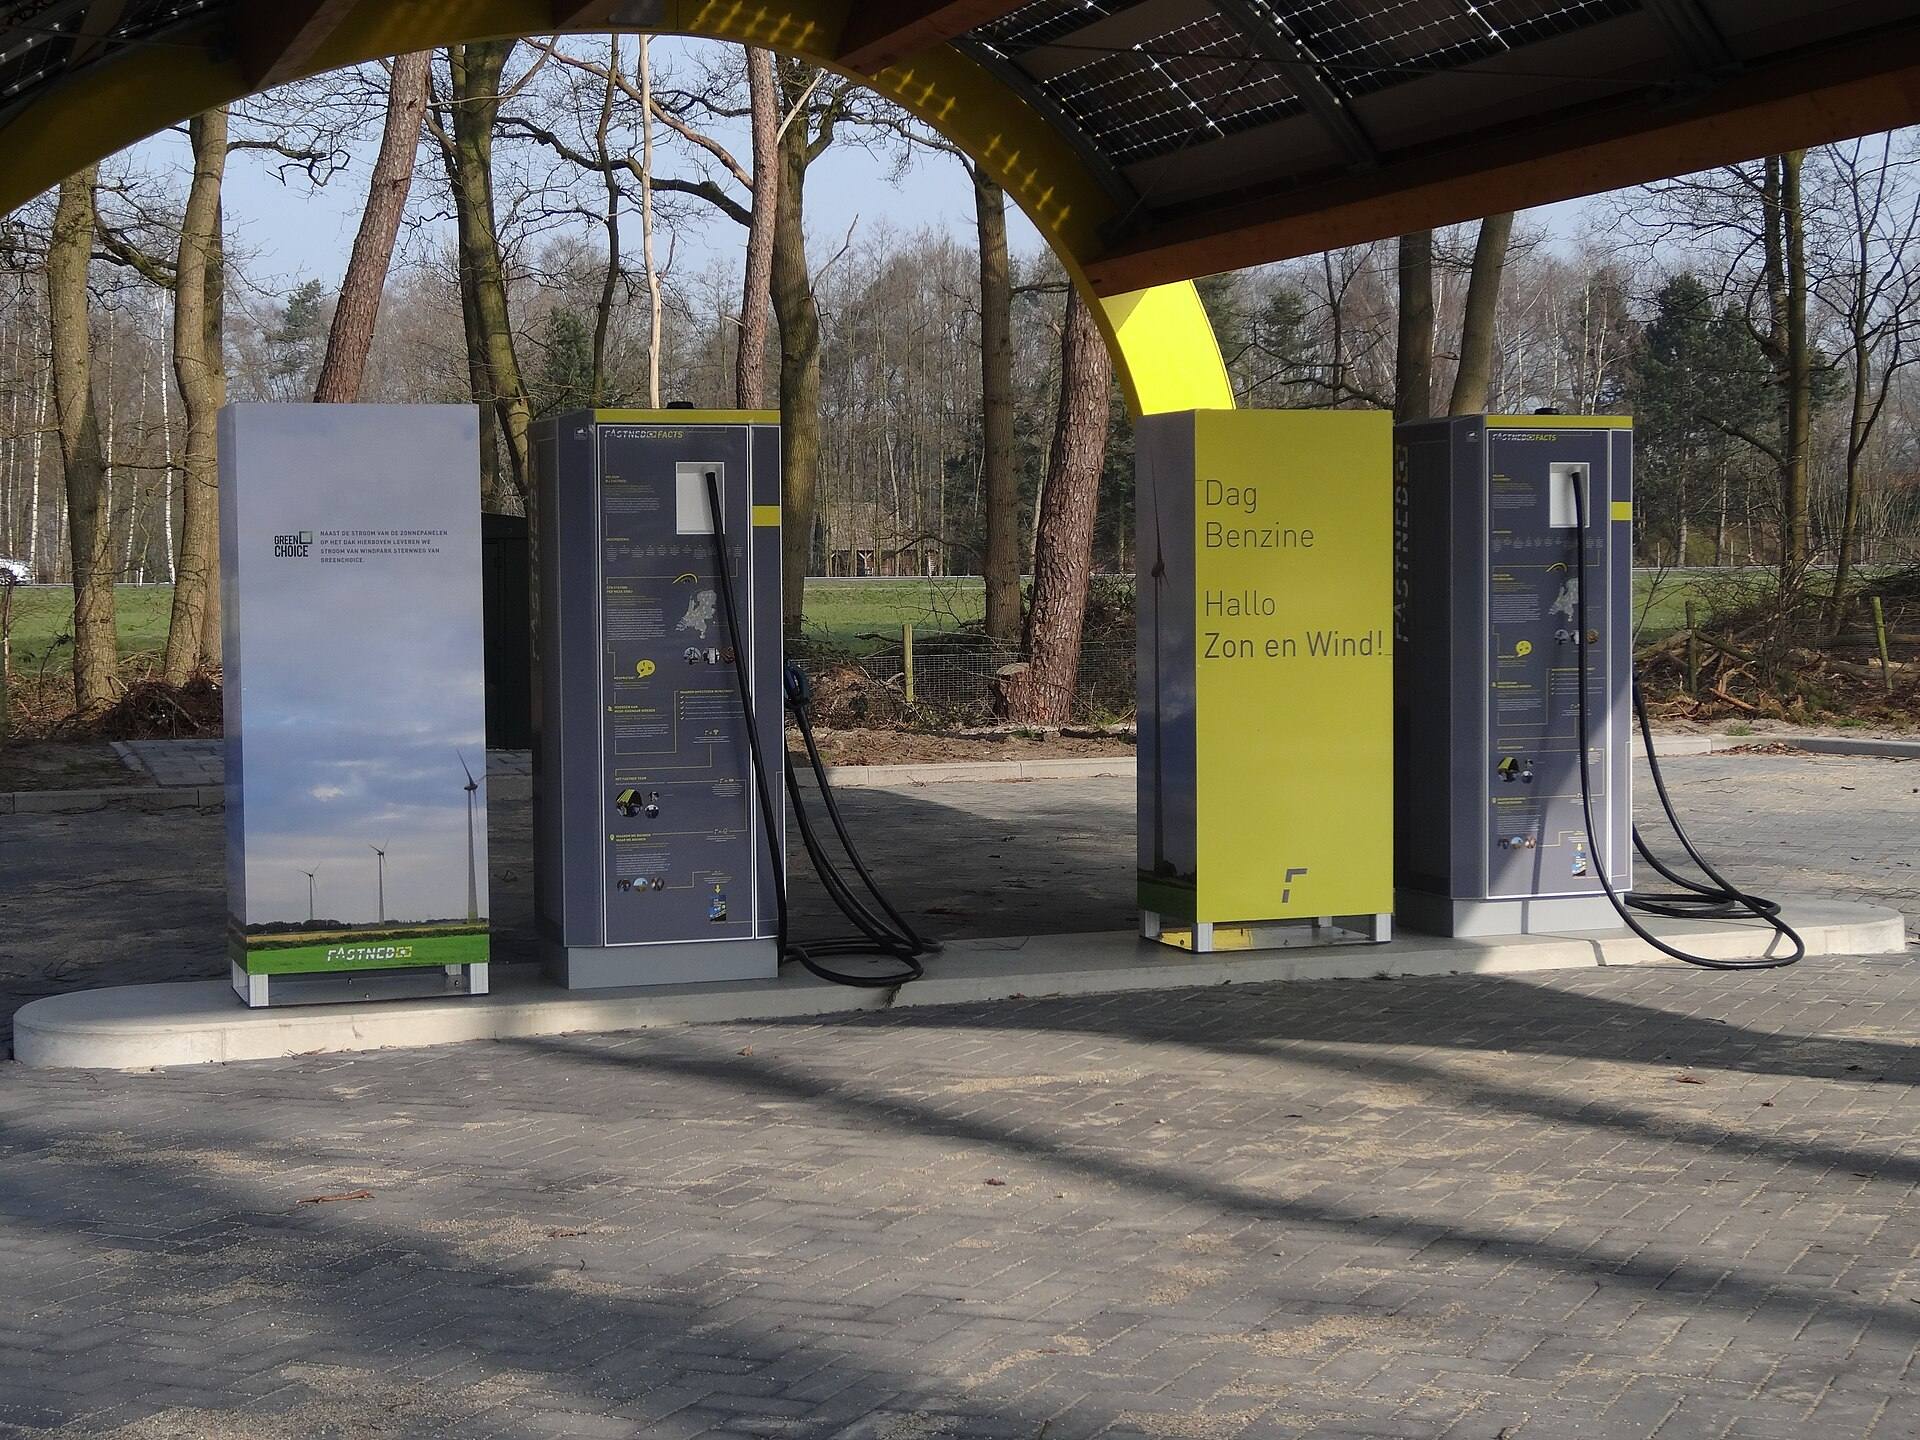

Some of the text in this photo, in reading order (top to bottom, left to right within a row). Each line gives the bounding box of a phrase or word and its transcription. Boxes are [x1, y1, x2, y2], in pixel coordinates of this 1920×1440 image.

[657, 430, 684, 439] FACTS
[1206, 479, 1257, 514] Dag
[274, 535, 299, 545] GREEN
[1206, 521, 1314, 548] Benzine
[274, 545, 309, 557] CHOICE
[1205, 590, 1276, 616] Hallo
[1204, 630, 1383, 659] Zon en Wind!
[327, 947, 395, 962] FASTNED
